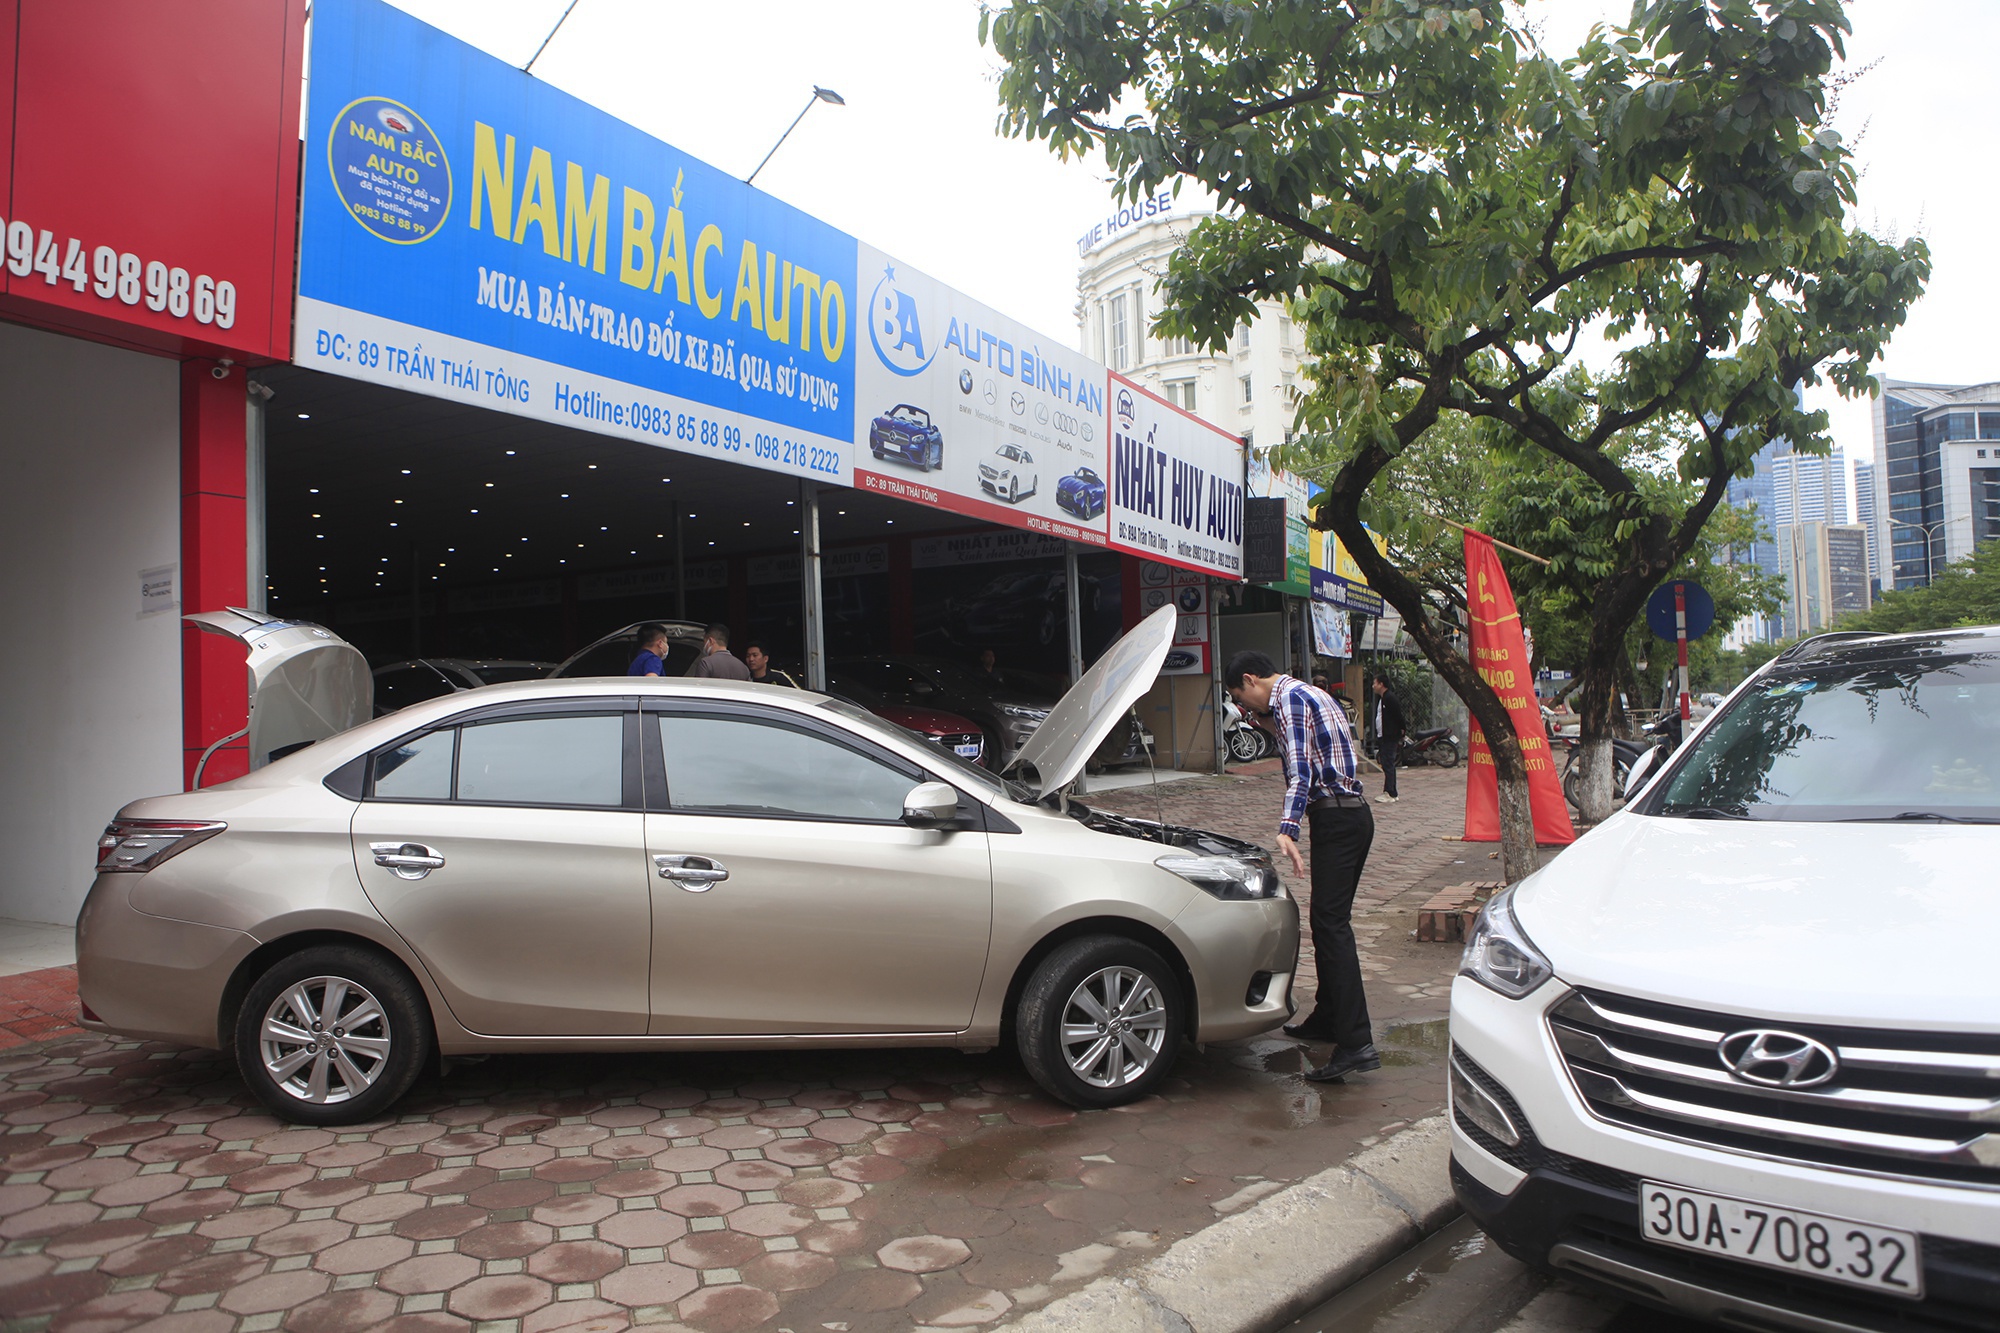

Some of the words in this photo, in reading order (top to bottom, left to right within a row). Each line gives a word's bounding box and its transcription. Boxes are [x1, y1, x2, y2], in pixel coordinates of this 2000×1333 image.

[349, 119, 396, 152] NAM
[401, 140, 437, 168] BẮC
[347, 164, 369, 178] Mua
[429, 195, 441, 205] xe
[366, 153, 419, 184] AUTO
[353, 203, 380, 220] 0983
[382, 213, 396, 225] 85
[397, 218, 411, 230] 88
[413, 223, 426, 234] 99
[374, 187, 392, 199] qua
[406, 198, 429, 213] dụng
[376, 199, 413, 218] Hotline:
[470, 120, 610, 275] NAM
[619, 167, 723, 320] BẮC
[730, 239, 846, 363] AUTO
[1077, 223, 1102, 256] TIME
[1107, 191, 1172, 235] HOUSE
[0, 216, 87, 293] 944
[93, 245, 142, 306] 98
[145, 260, 190, 318] 98
[193, 274, 236, 330] 69
[476, 266, 532, 319] MUA
[647, 310, 682, 364] ĐỔI
[684, 334, 708, 372] XE
[711, 339, 736, 381] ĐÃ
[739, 353, 773, 392] QUA
[776, 356, 798, 398] SỬ
[800, 372, 839, 413] DỤNG
[316, 329, 351, 362] ĐC:
[358, 340, 379, 368] 89
[385, 343, 435, 381] TRẦN
[441, 360, 480, 392] THÁI
[485, 368, 530, 403] TÔNG
[944, 316, 1015, 377] AUTO
[1021, 345, 1072, 403] BÌNH
[1076, 379, 1102, 417] AN
[959, 404, 972, 415] BMW
[677, 413, 696, 442] 85
[701, 419, 719, 447] 88
[723, 425, 741, 452] 99
[755, 433, 779, 460] 098
[783, 440, 807, 468] 218
[810, 446, 840, 475] 2222
[1057, 439, 1072, 451] Audi
[879, 479, 886, 490] 89
[1115, 423, 1167, 520] NHẤT
[1171, 457, 1204, 533] HUY
[1206, 474, 1243, 547] AUTO
[997, 533, 1031, 547] HUY
[1027, 516, 1051, 532] HOTLINE:
[1650, 1192, 1908, 1287] 30A-708.32
